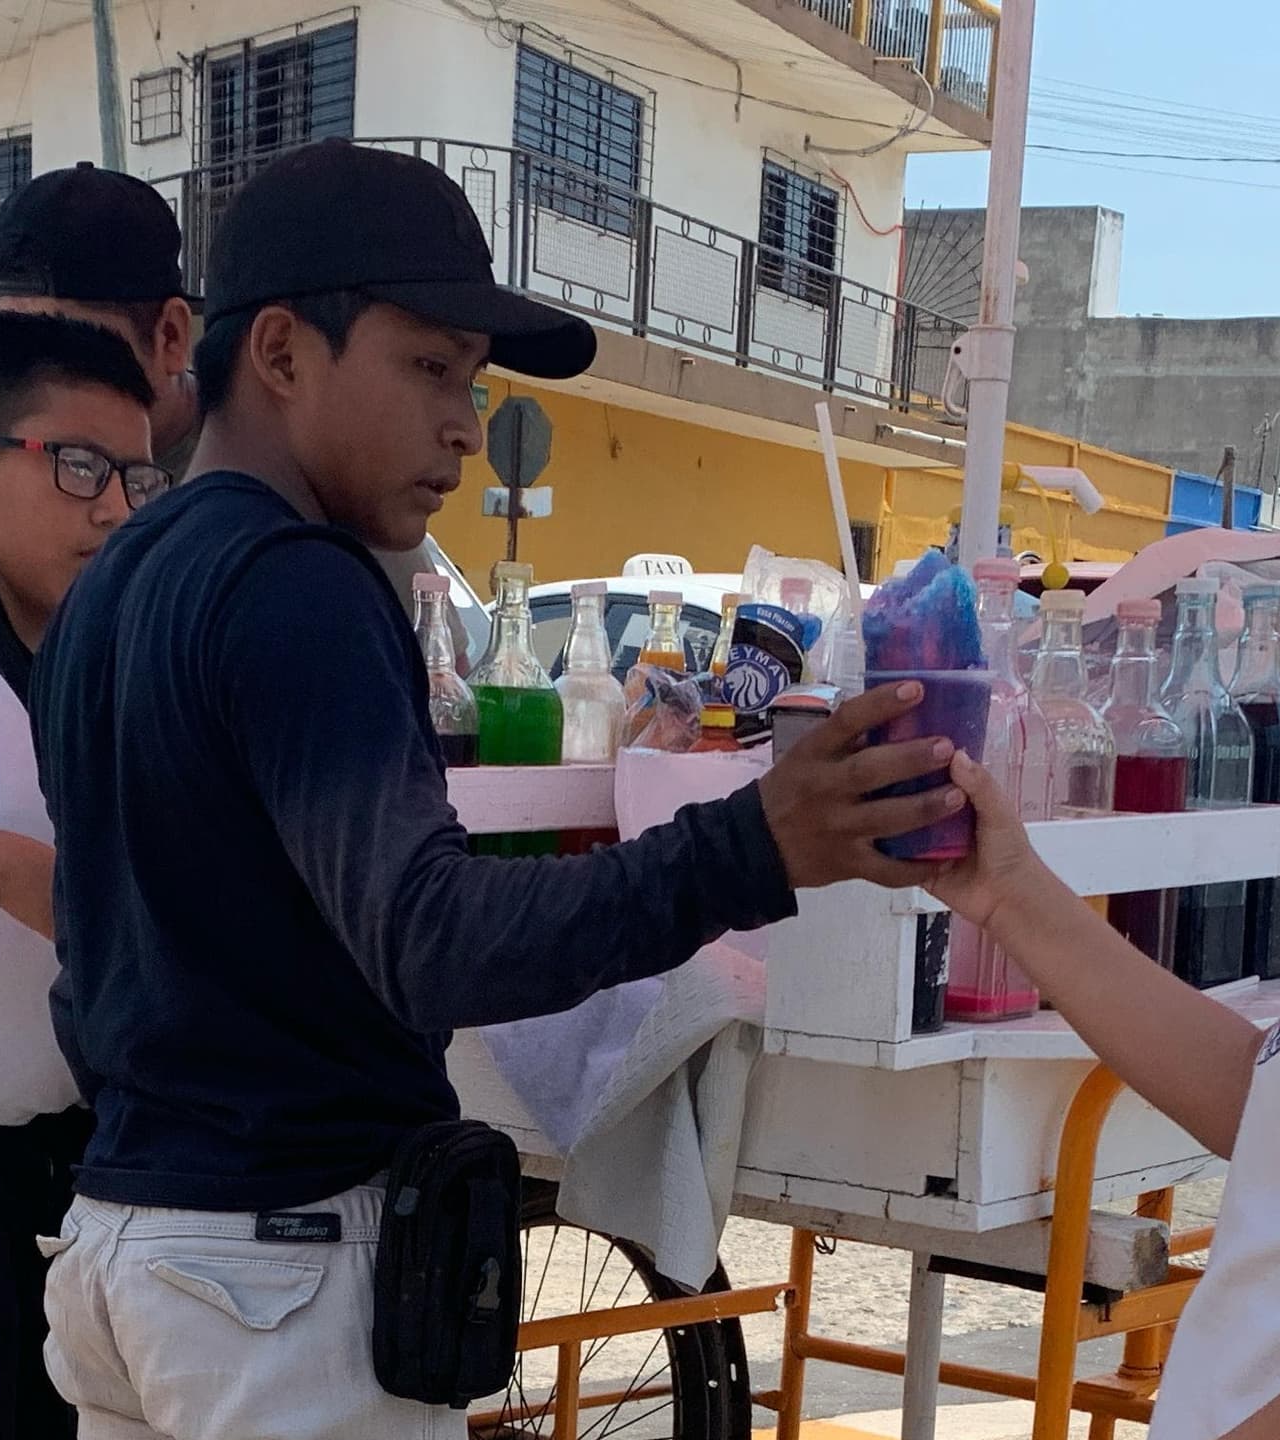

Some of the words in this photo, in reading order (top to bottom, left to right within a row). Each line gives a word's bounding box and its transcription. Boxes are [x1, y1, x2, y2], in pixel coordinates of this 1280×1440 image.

[640, 559, 684, 576] TAXI
[728, 644, 781, 677] EYMA
[267, 1216, 304, 1227] PEPE
